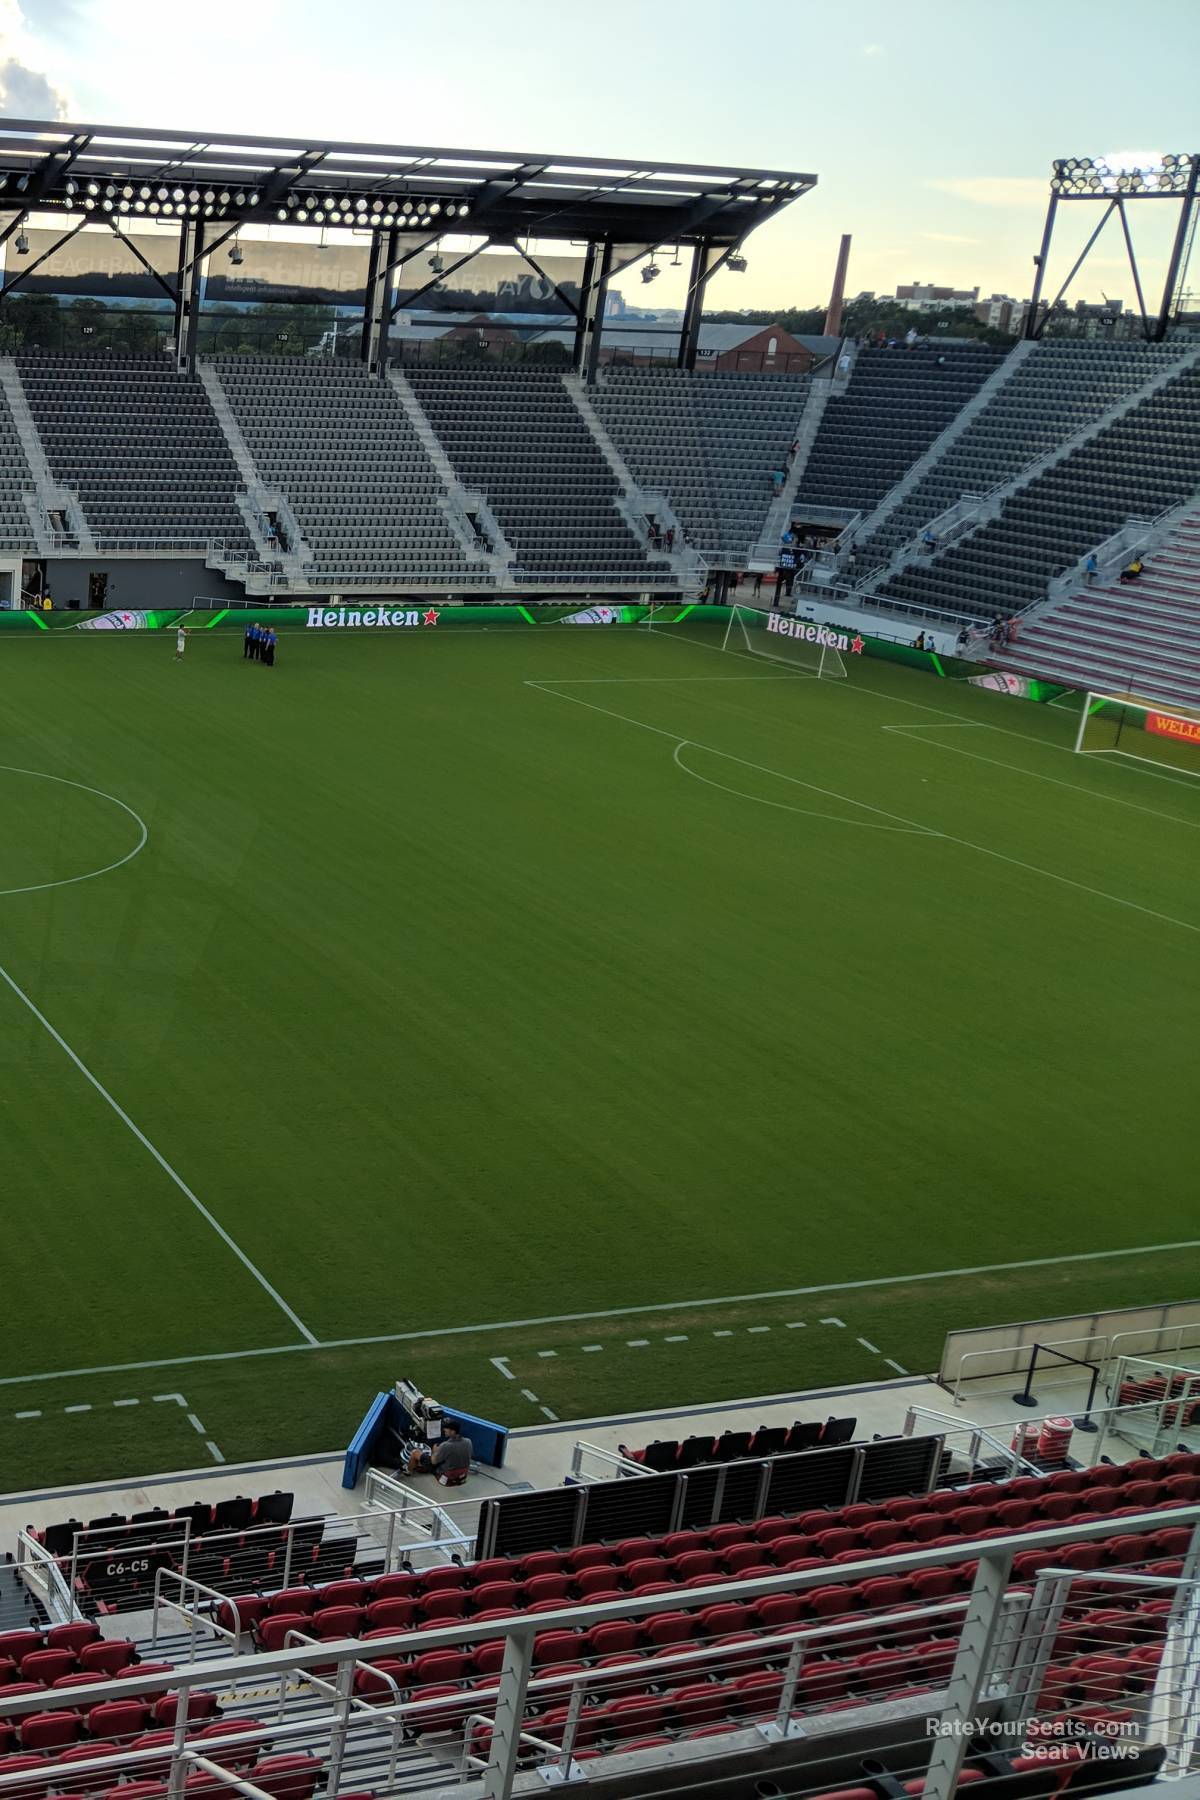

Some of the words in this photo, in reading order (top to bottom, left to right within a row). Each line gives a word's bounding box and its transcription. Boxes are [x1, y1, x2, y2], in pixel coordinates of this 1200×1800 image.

[306, 607, 419, 628] Heineken
[766, 612, 849, 651] Heineken
[106, 1559, 149, 1576] C6-C5
